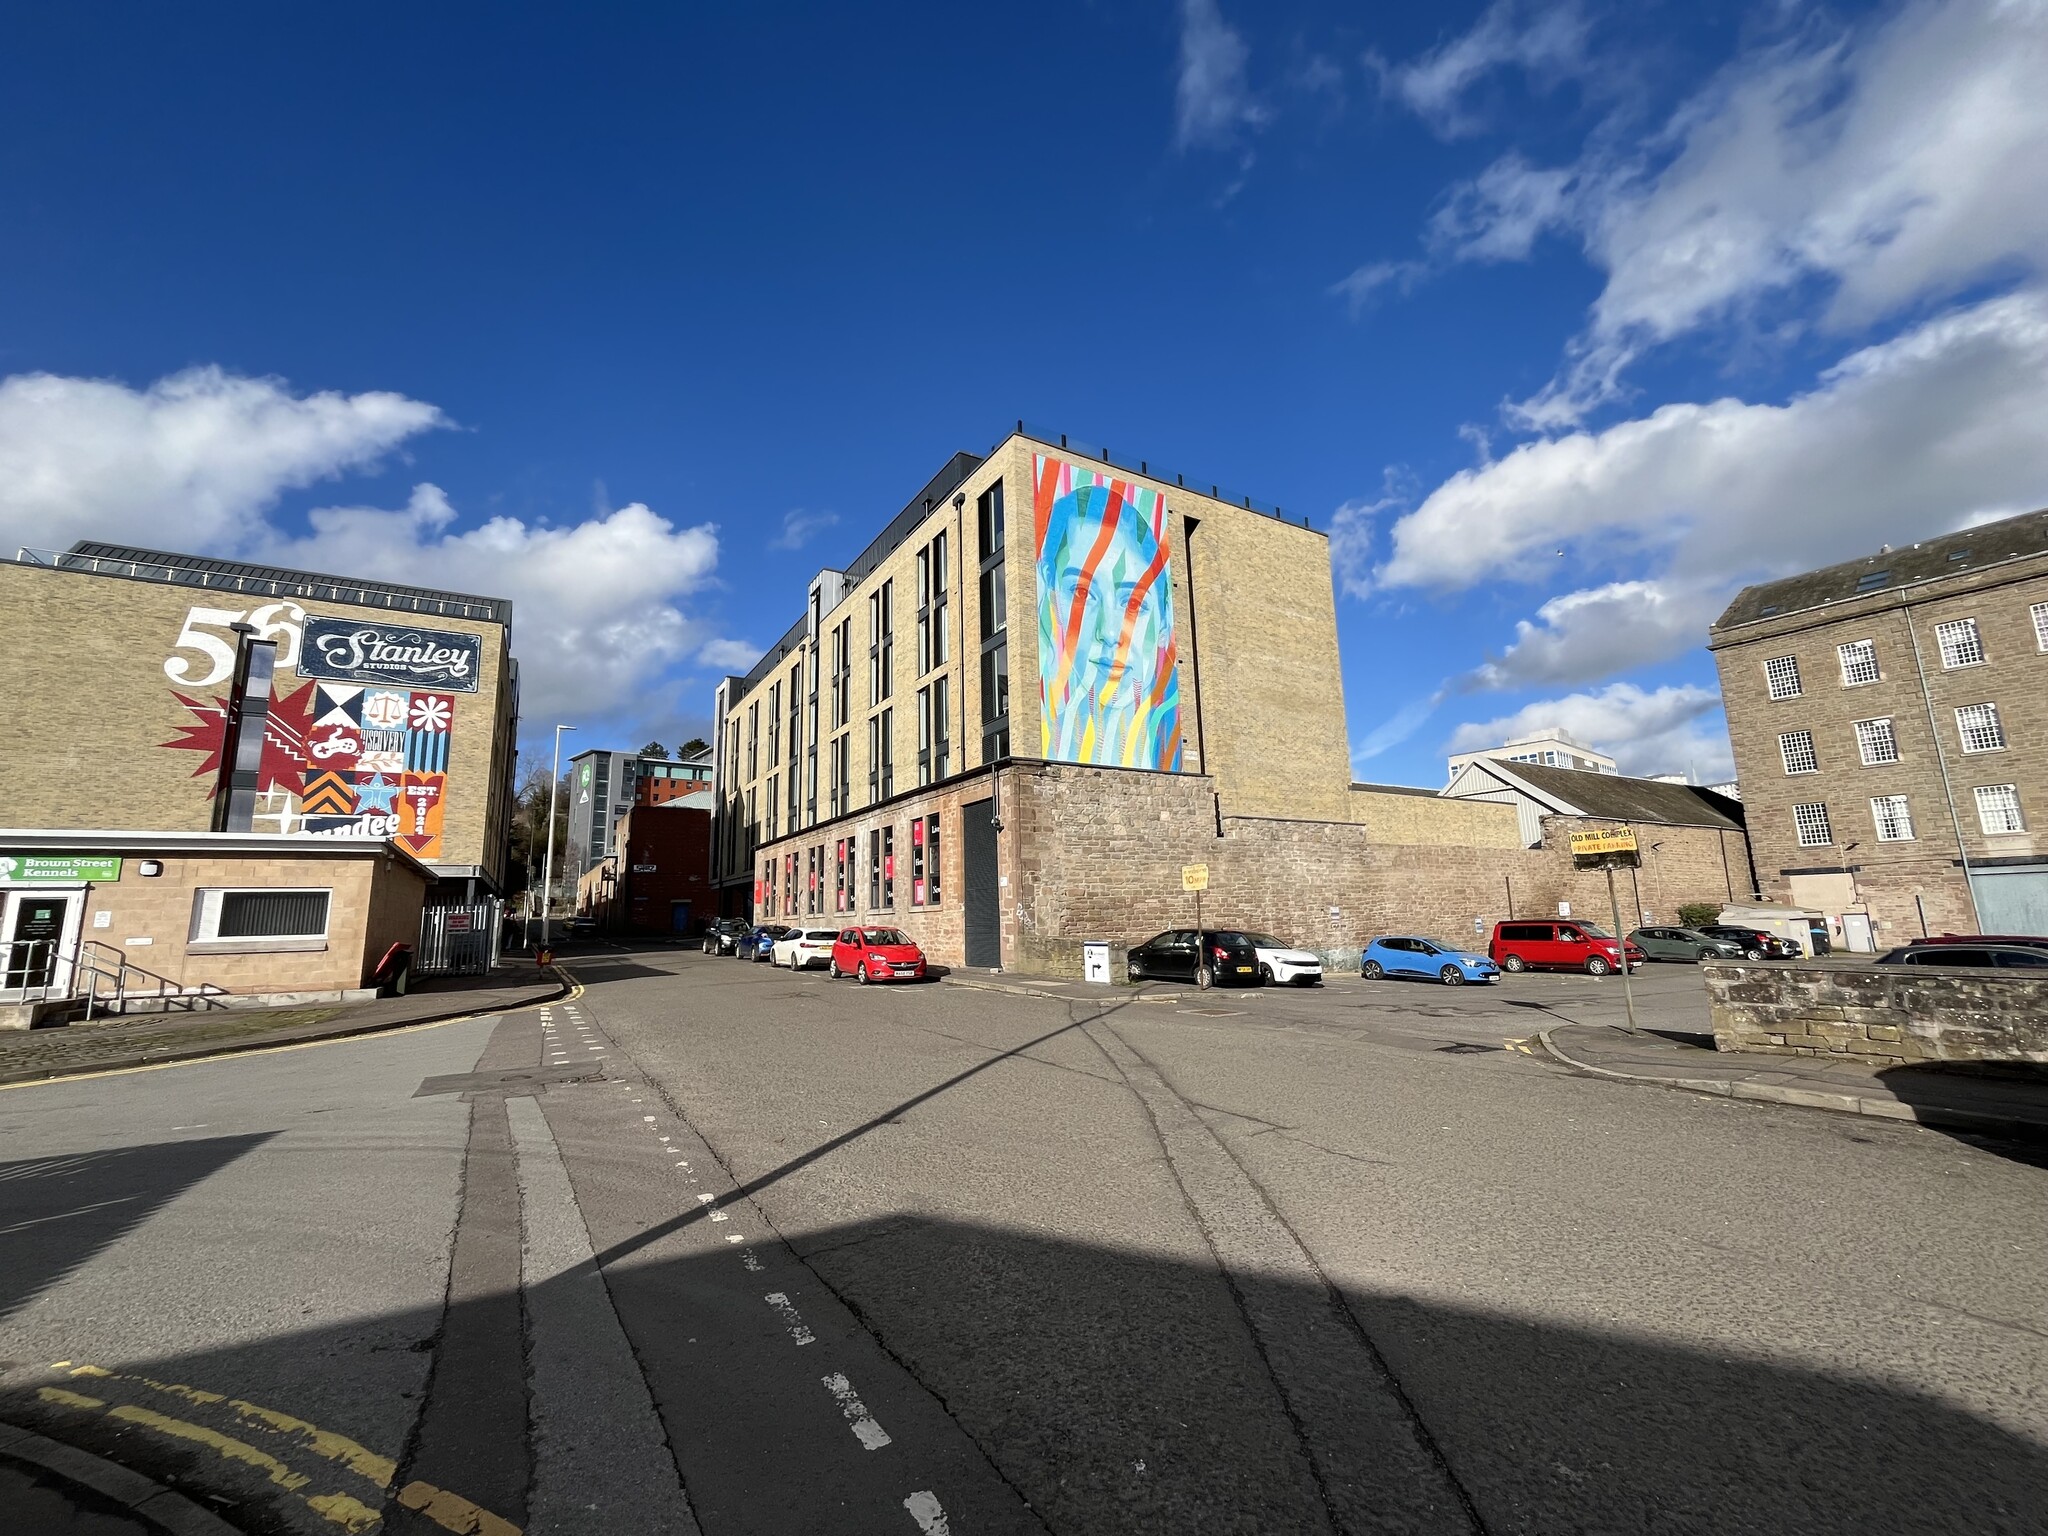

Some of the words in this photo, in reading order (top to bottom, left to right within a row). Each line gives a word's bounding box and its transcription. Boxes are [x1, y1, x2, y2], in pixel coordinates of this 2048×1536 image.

[163, 602, 306, 686] 56
[316, 630, 470, 676] Stanley
[362, 662, 407, 671] STUDIOS
[360, 729, 405, 752] DISCOVERY
[407, 786, 438, 797] EST.
[416, 798, 427, 834] 2024
[1585, 832, 1600, 840] MILL
[24, 858, 70, 868] Brown
[72, 859, 113, 868] Street
[23, 868, 78, 877] Kennels
